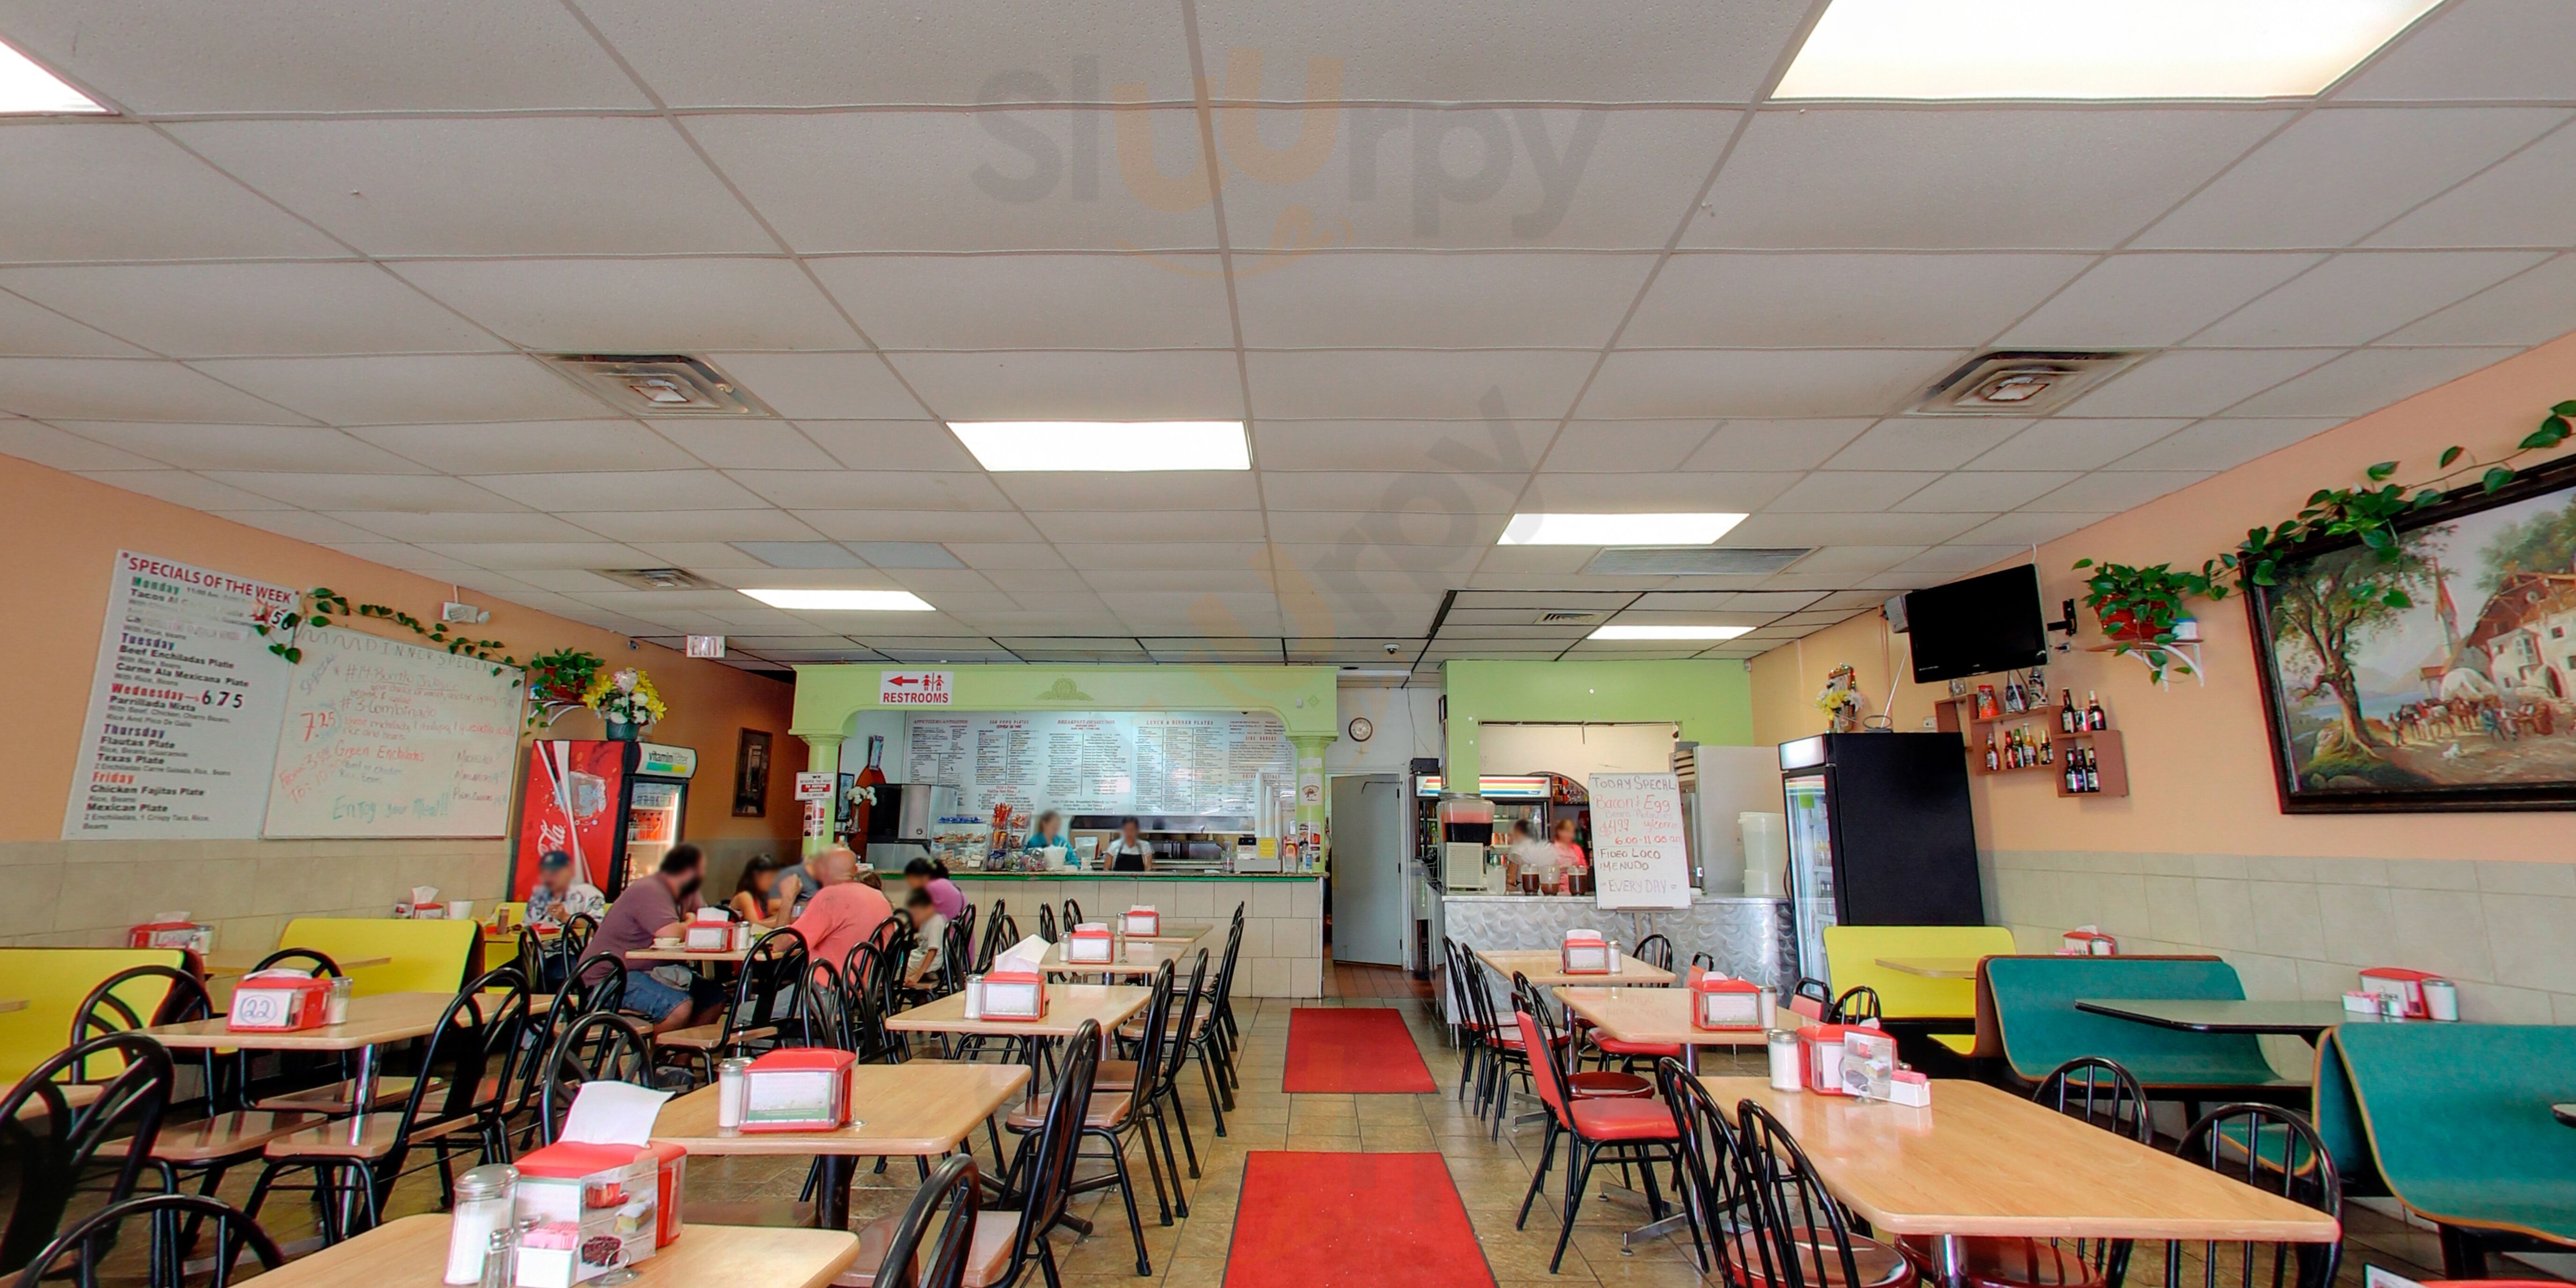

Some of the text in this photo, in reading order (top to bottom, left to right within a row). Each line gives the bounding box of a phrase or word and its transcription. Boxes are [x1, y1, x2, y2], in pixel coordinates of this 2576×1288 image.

[132, 576, 180, 595] Monday
[203, 575, 222, 588] OF
[225, 578, 252, 595] THE
[130, 588, 164, 602] Tacos
[121, 632, 175, 651] Tuesday
[119, 644, 148, 656] Beef
[150, 649, 206, 665] Enchiladas
[116, 662, 151, 674] Carne
[175, 670, 221, 684] Mexicana
[225, 677, 249, 687] Plate
[111, 682, 184, 702] Wednesday
[883, 692, 949, 703] RESTROOMS
[109, 695, 196, 711] Parrillada Mixta
[104, 724, 166, 739] Thursday
[100, 736, 176, 749] Flautas Plate
[334, 739, 370, 757] Green
[97, 753, 165, 764] Texas Plate
[92, 771, 135, 785] Friday
[89, 785, 205, 796] Chicken Fajitas Plate
[86, 803, 168, 812] Mexican Plate
[1592, 794, 1634, 809] Bacon
[1644, 794, 1671, 813] Egg
[1600, 848, 1661, 859] FIDEO LOCO
[1645, 880, 1667, 894] DAY
[244, 999, 270, 1019] 22
